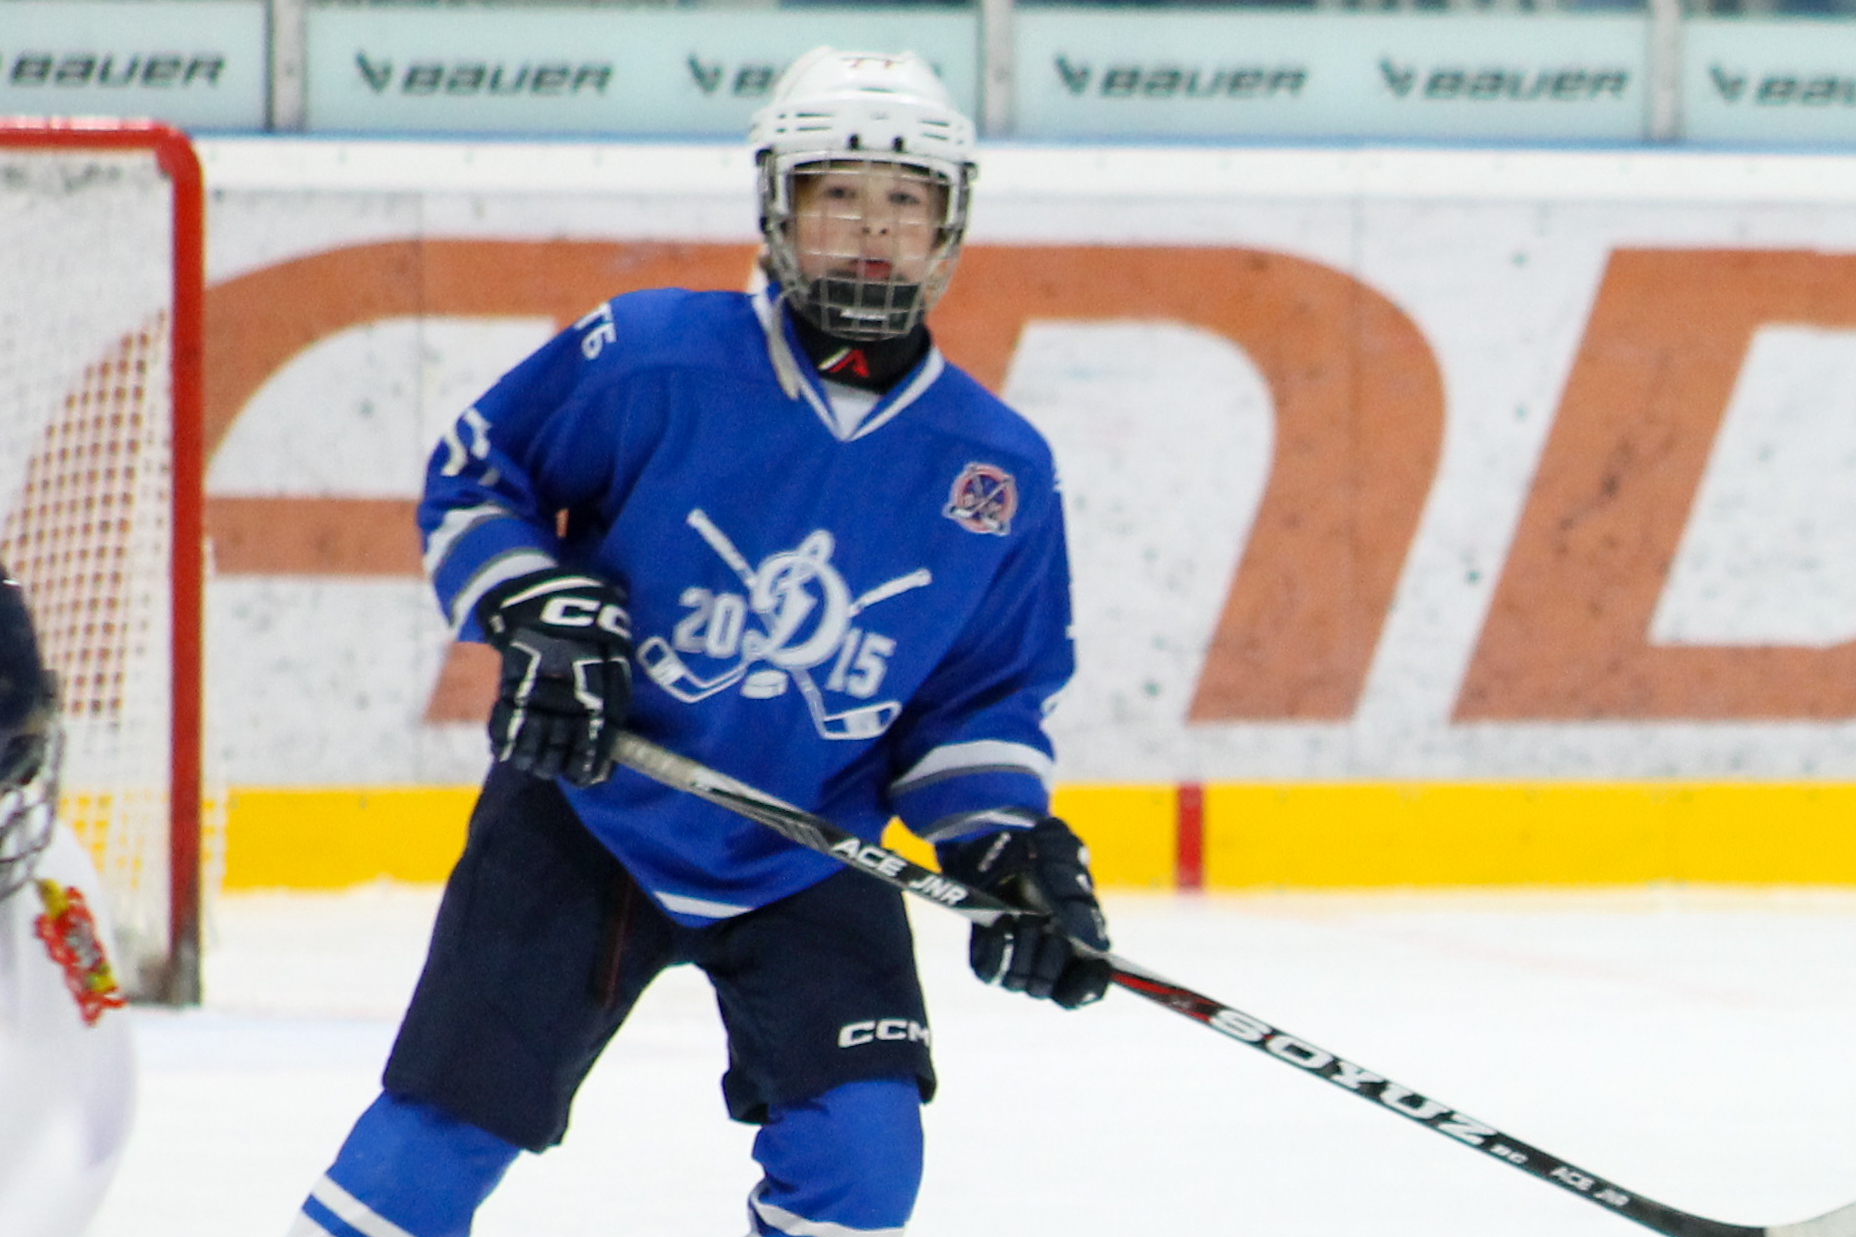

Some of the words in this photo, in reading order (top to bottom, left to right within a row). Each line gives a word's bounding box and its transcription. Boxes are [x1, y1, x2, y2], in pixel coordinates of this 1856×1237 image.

[10, 52, 226, 88] BAUER
[402, 62, 613, 96] BAUER
[1099, 66, 1307, 98] BAUER
[1424, 69, 1629, 98] BAUER
[672, 586, 747, 659] 20
[824, 628, 898, 700] 15
[831, 837, 906, 878] ACE
[1207, 1005, 1500, 1148] SOYUZ
